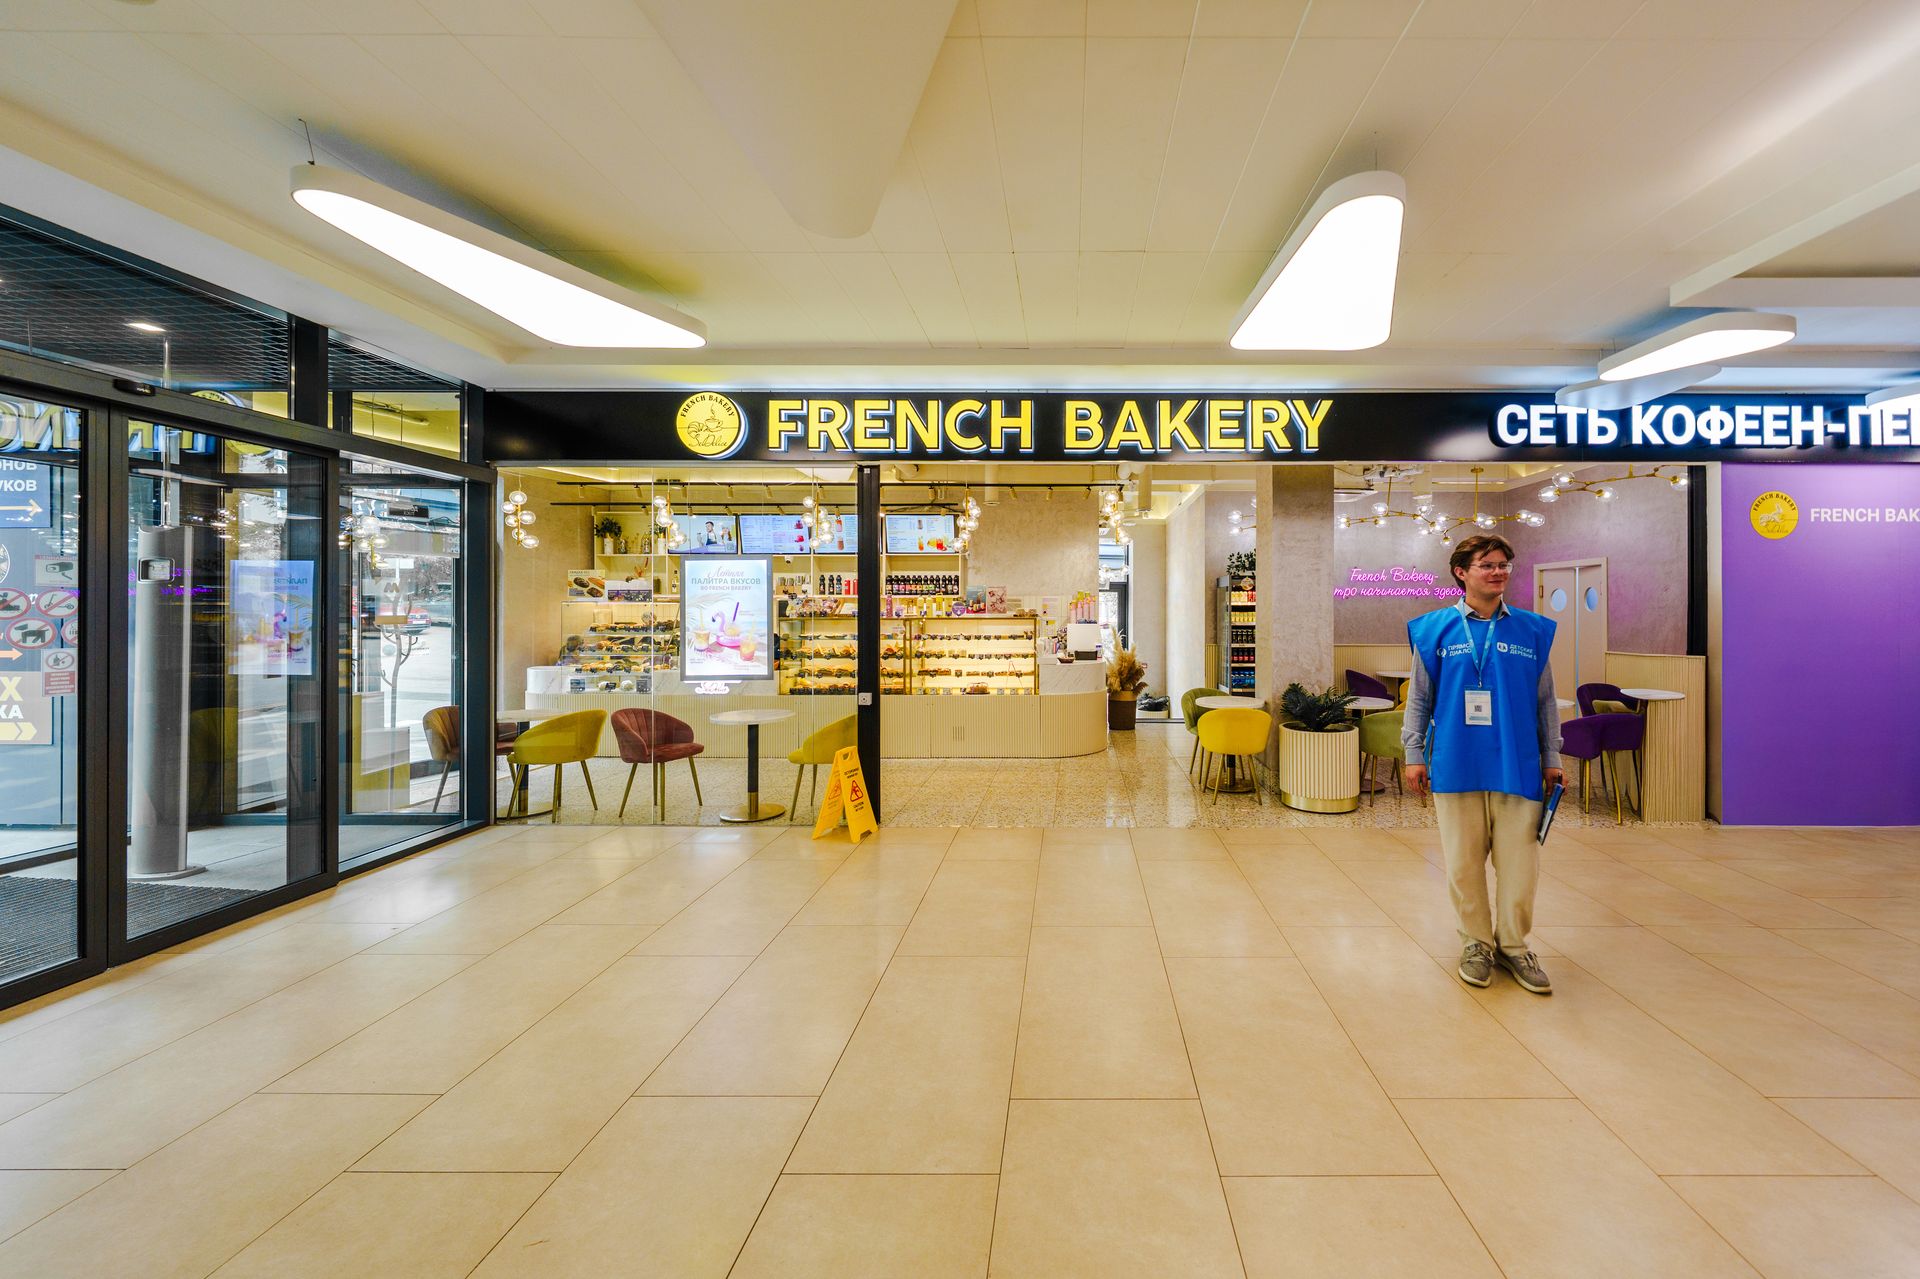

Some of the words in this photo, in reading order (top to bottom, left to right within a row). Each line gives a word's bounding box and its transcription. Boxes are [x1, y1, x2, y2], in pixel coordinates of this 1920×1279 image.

[680, 394, 707, 418] FRENCH
[708, 394, 735, 417] BAKERY
[767, 398, 1035, 454] FRENCH
[1062, 398, 1334, 454] BAKERY
[1496, 403, 1618, 446] СЕТЬ
[0, 459, 37, 471] НОВ
[1810, 508, 1880, 523] FRENCH
[1885, 508, 1920, 523] BAK
[691, 577, 728, 585] ПАЛИТРА
[730, 577, 761, 585] ВКУСОВ
[1350, 568, 1387, 582] French
[1334, 587, 1358, 599] тро
[1360, 587, 1430, 597] начинается
[1449, 648, 1472, 657] ДИАЛО
